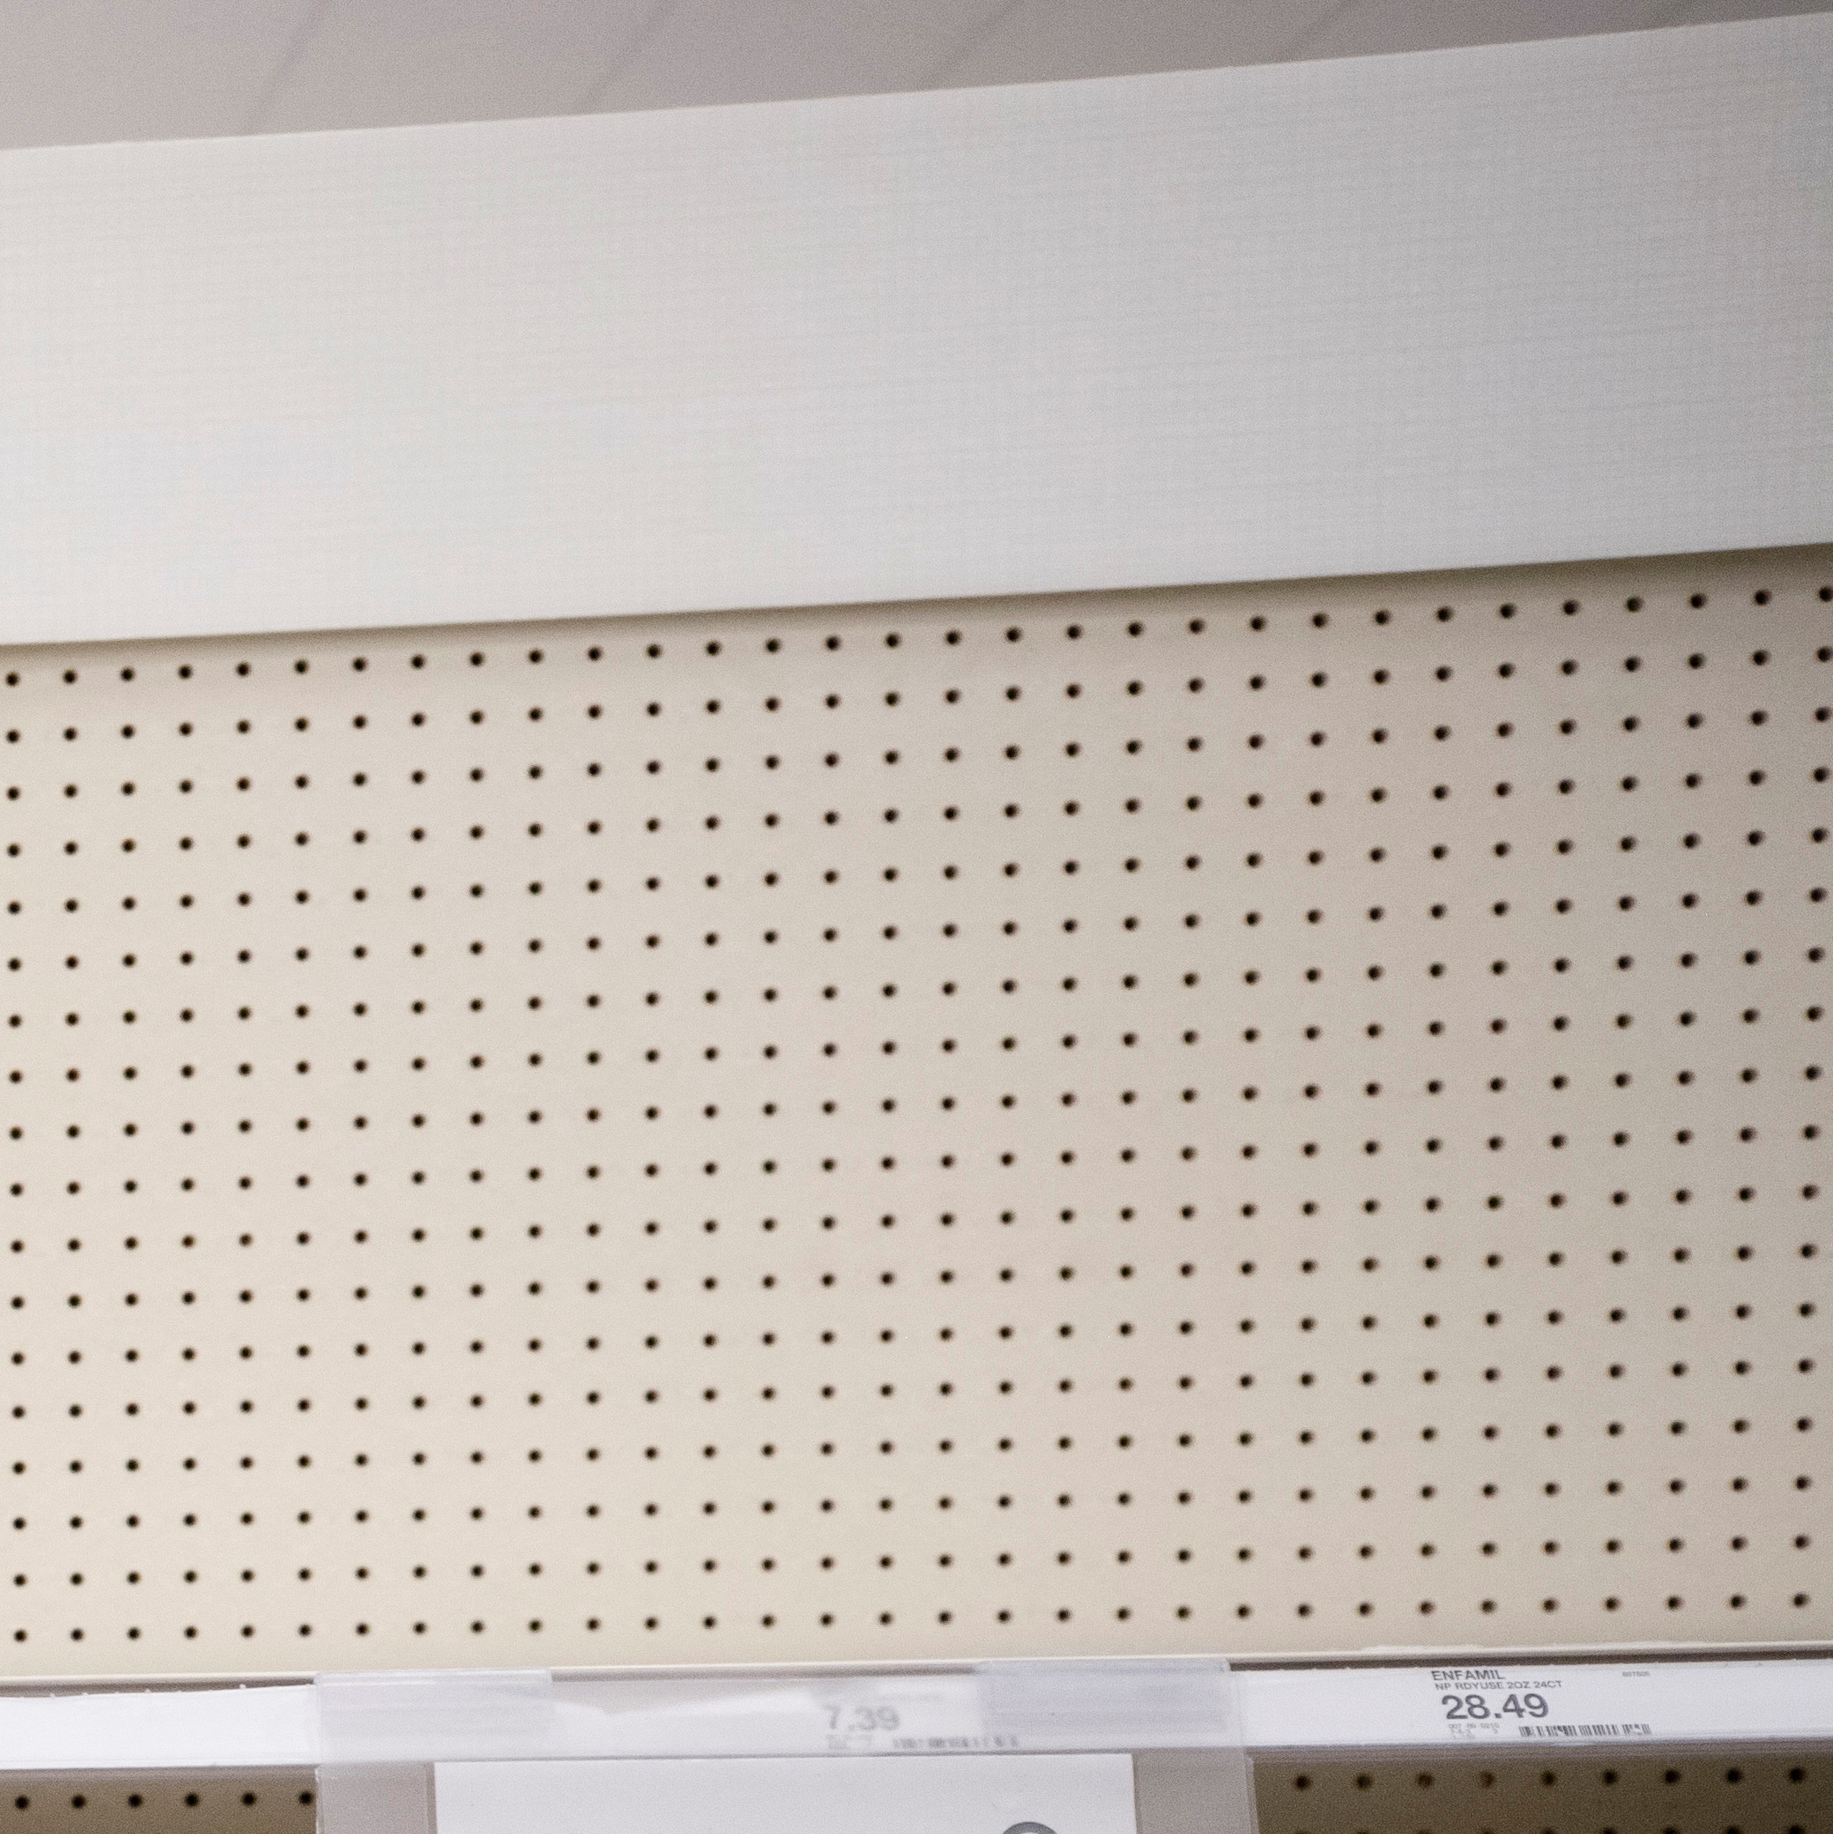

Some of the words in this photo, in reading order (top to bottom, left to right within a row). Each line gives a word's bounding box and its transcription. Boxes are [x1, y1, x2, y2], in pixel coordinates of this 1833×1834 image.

[1431, 1670, 1505, 1680] ENFAMIL
[824, 1705, 900, 1731] 7.39
[1441, 1694, 1549, 1720] 28.49
